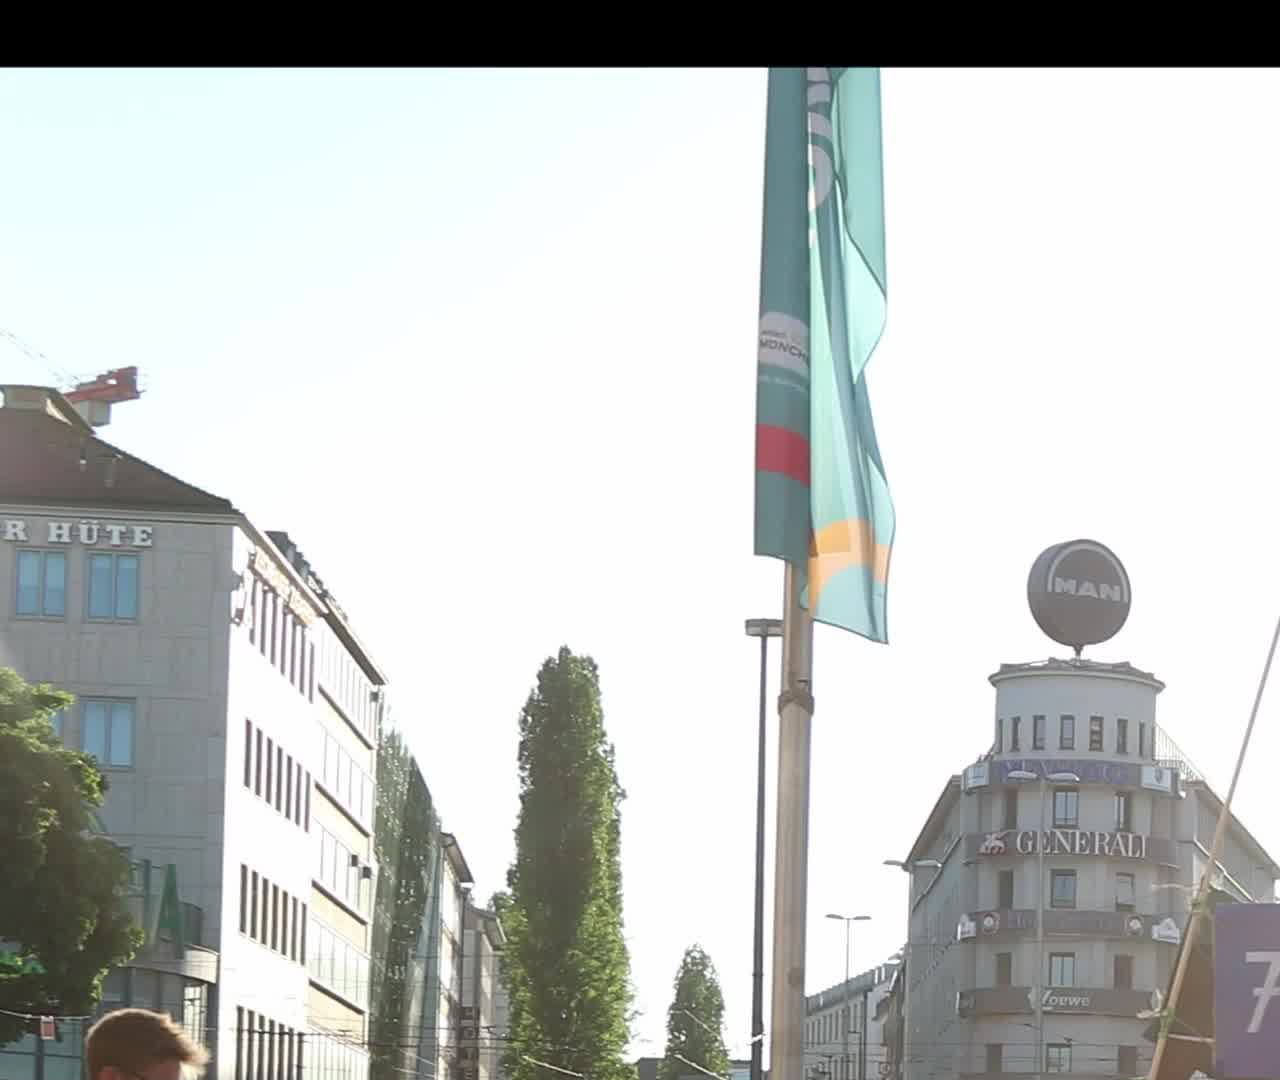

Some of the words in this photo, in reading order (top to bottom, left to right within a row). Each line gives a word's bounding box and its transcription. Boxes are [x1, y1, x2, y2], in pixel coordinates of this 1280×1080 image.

[3, 519, 28, 542] R
[48, 519, 153, 547] HÜTE
[1054, 577, 1121, 602] MAN
[1016, 830, 1147, 859] GENERALI
